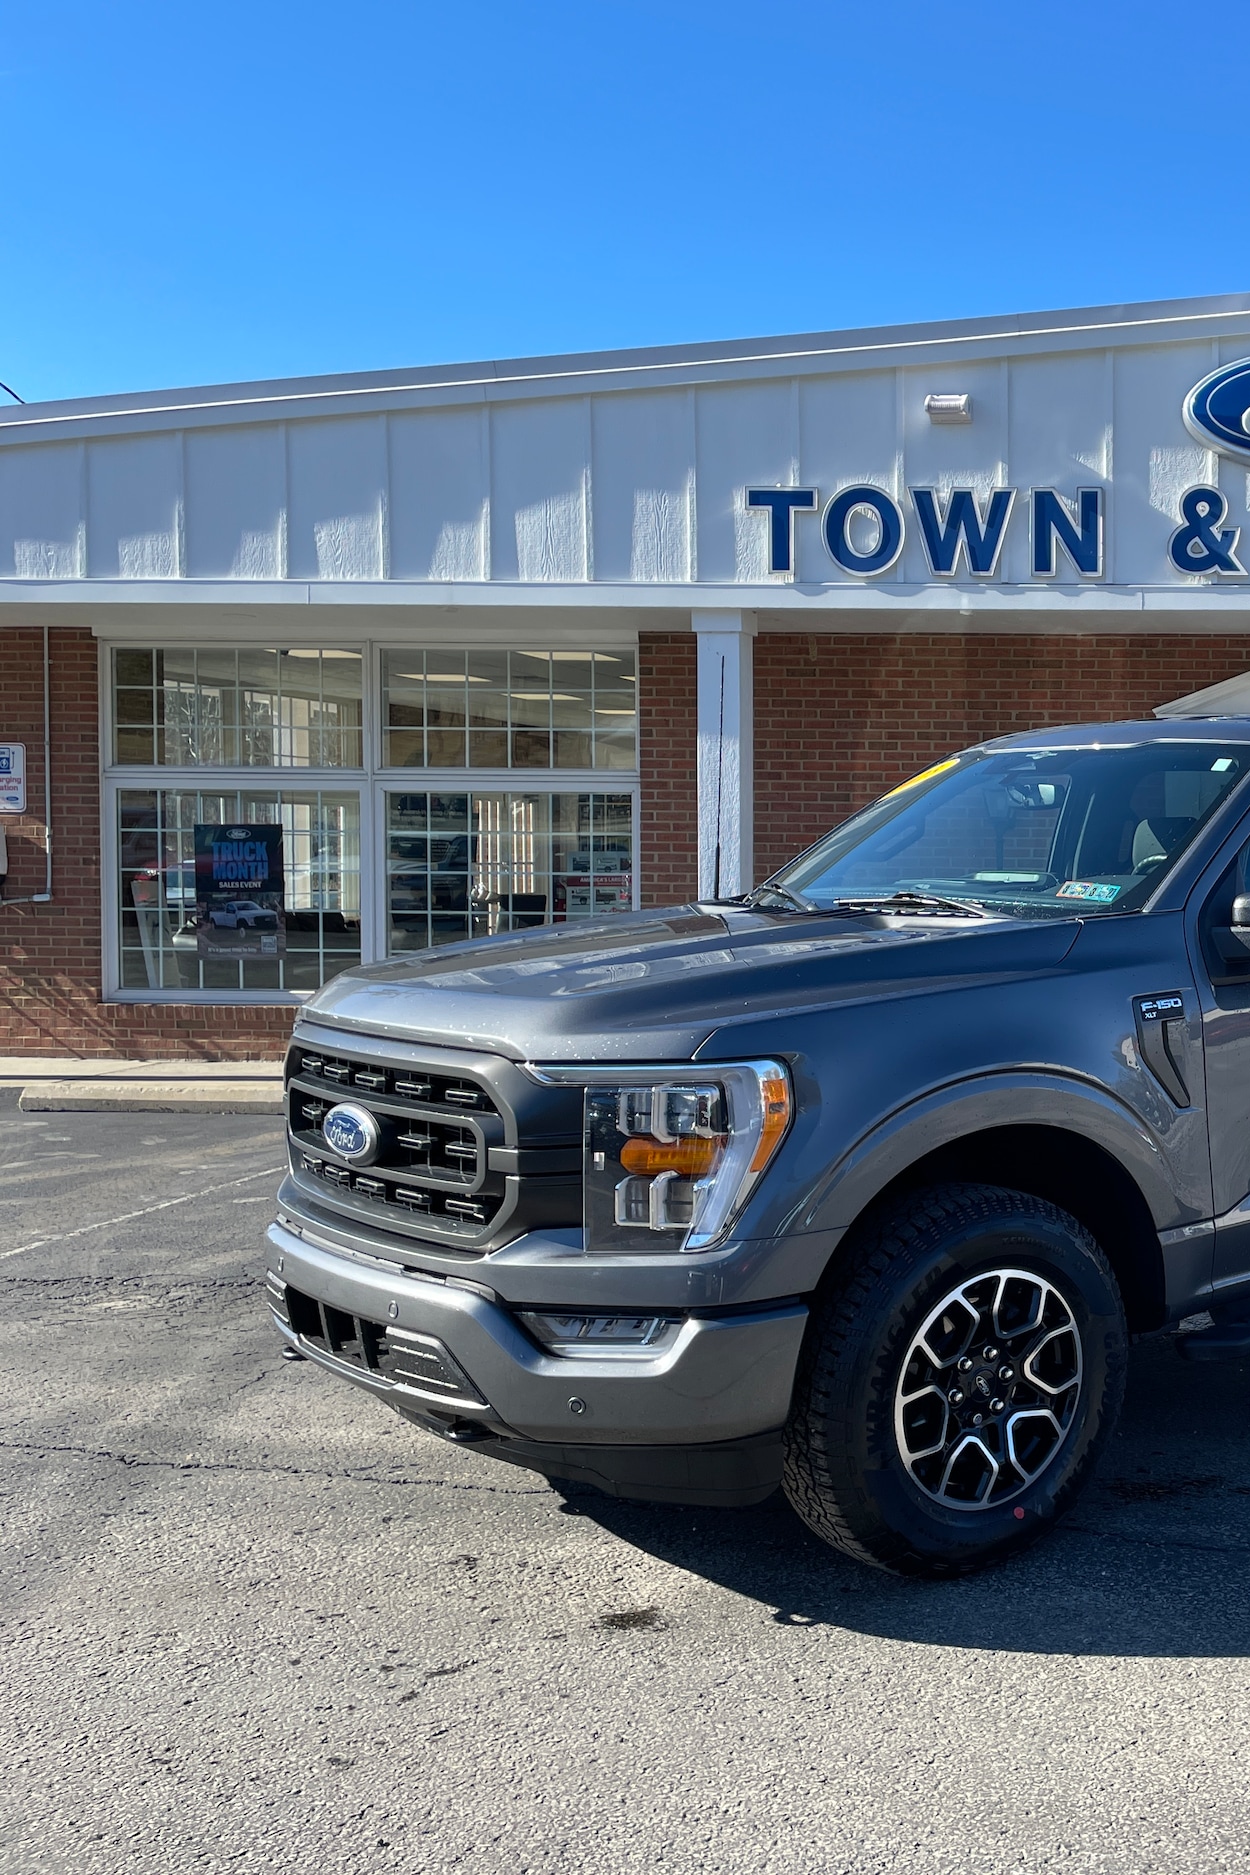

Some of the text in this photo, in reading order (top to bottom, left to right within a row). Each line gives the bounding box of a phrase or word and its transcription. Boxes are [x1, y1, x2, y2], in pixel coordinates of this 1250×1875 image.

[746, 484, 1103, 577] TOWN
[1168, 483, 1248, 577] &
[212, 841, 268, 861] TRUCK
[213, 861, 269, 880] MONTH
[219, 881, 262, 889] SALES EVENT
[1141, 997, 1182, 1011] F-150
[1145, 1011, 1157, 1019] XLT
